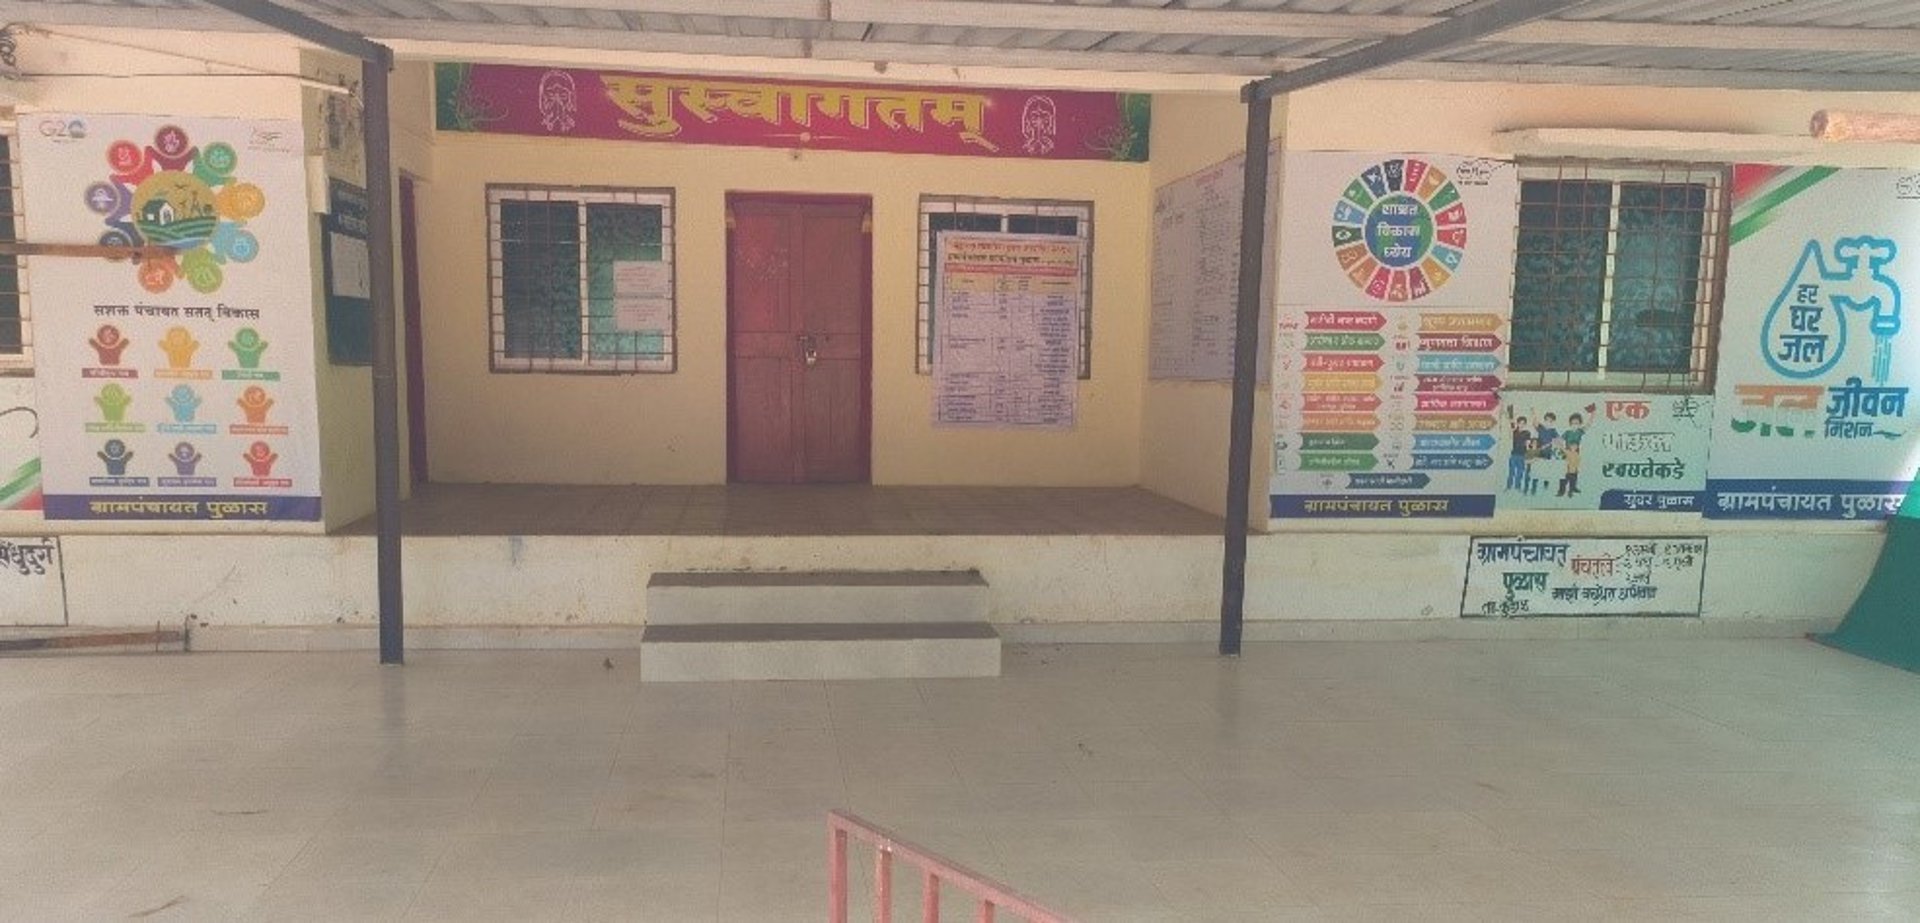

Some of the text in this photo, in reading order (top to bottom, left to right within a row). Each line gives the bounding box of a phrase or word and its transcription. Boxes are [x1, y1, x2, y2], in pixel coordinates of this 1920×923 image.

[600, 75, 1000, 152] सुस्वागतम्
[1376, 221, 1420, 236] विकास
[1797, 284, 1819, 304] हर
[1790, 305, 1823, 332] घर
[1778, 334, 1828, 362] जल
[1826, 377, 1908, 419] जीवन
[1604, 401, 1652, 421] एक
[1824, 419, 1874, 438] मिशन
[1304, 495, 1449, 517] ग्रामपंचायत पुळास
[1717, 486, 1834, 511] ग्रामपंचायत
[206, 501, 267, 519] पुळास
